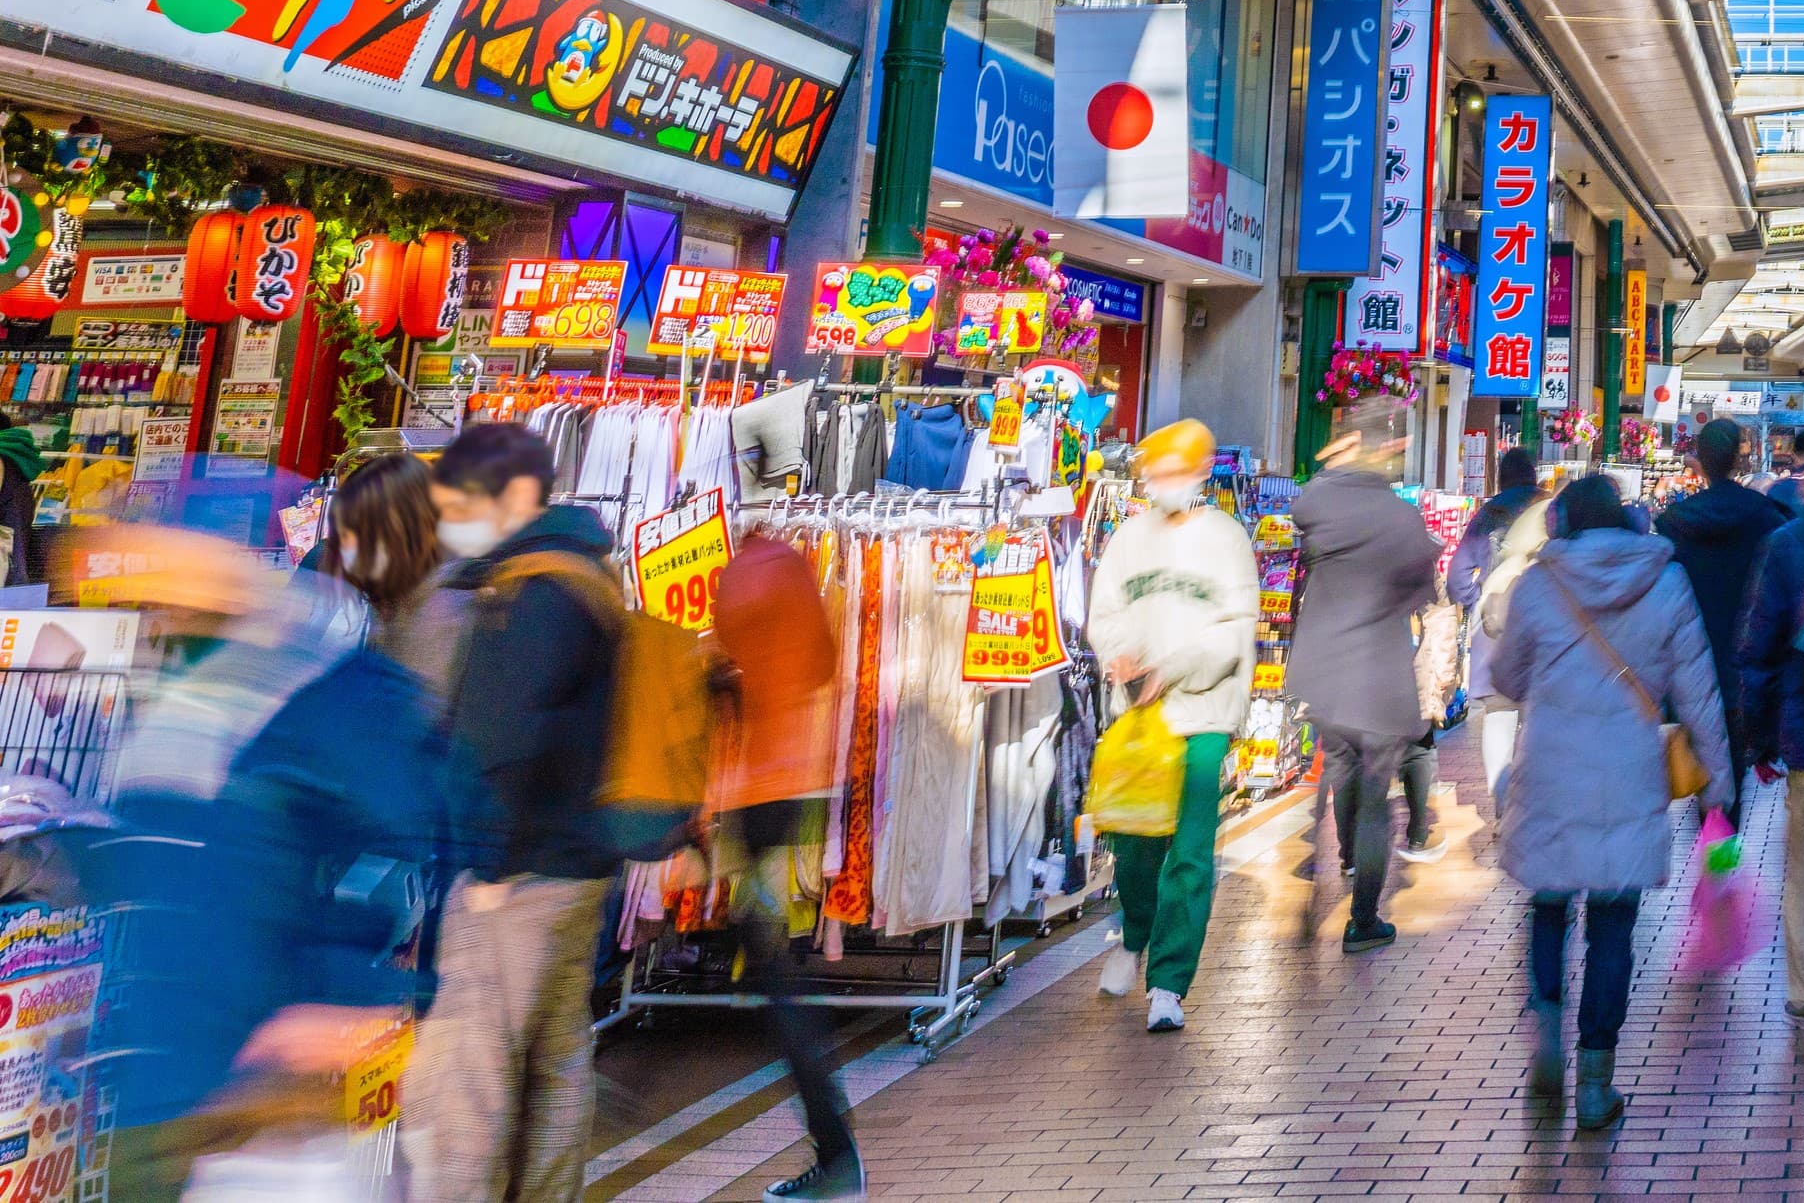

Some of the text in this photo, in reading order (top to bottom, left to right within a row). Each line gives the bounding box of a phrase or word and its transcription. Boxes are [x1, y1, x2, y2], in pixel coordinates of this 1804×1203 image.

[638, 43, 685, 73] Produced by
[1315, 19, 1378, 237] パシオス
[251, 213, 304, 314] ぴかそ
[1486, 111, 1539, 381] カラオケ館
[553, 302, 615, 338] 698
[726, 311, 776, 347] 1,200
[815, 326, 857, 346] 598
[977, 609, 1017, 629] SALE
[972, 650, 1030, 667] 999
